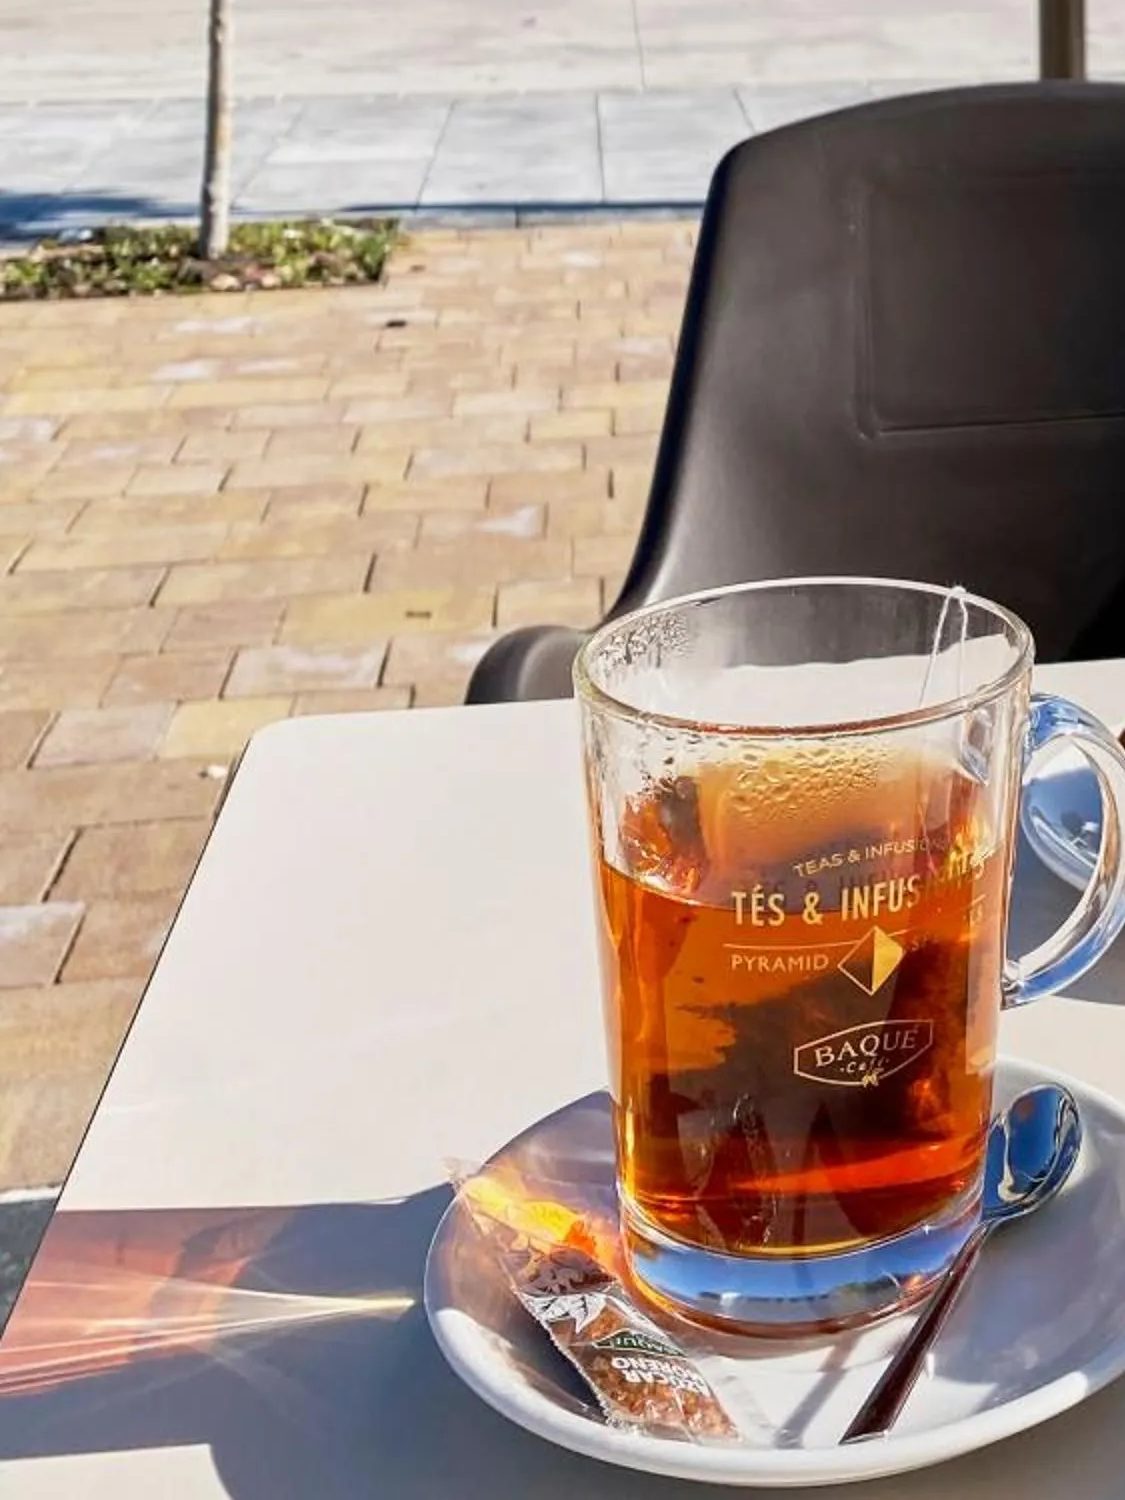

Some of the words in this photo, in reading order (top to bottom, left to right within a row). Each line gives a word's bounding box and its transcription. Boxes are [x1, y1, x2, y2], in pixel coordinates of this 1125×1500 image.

[793, 853, 843, 878] TEAS
[847, 850, 861, 864] &
[731, 883, 785, 927] TÉS
[802, 891, 824, 926] &
[730, 953, 830, 974] PYRAMID
